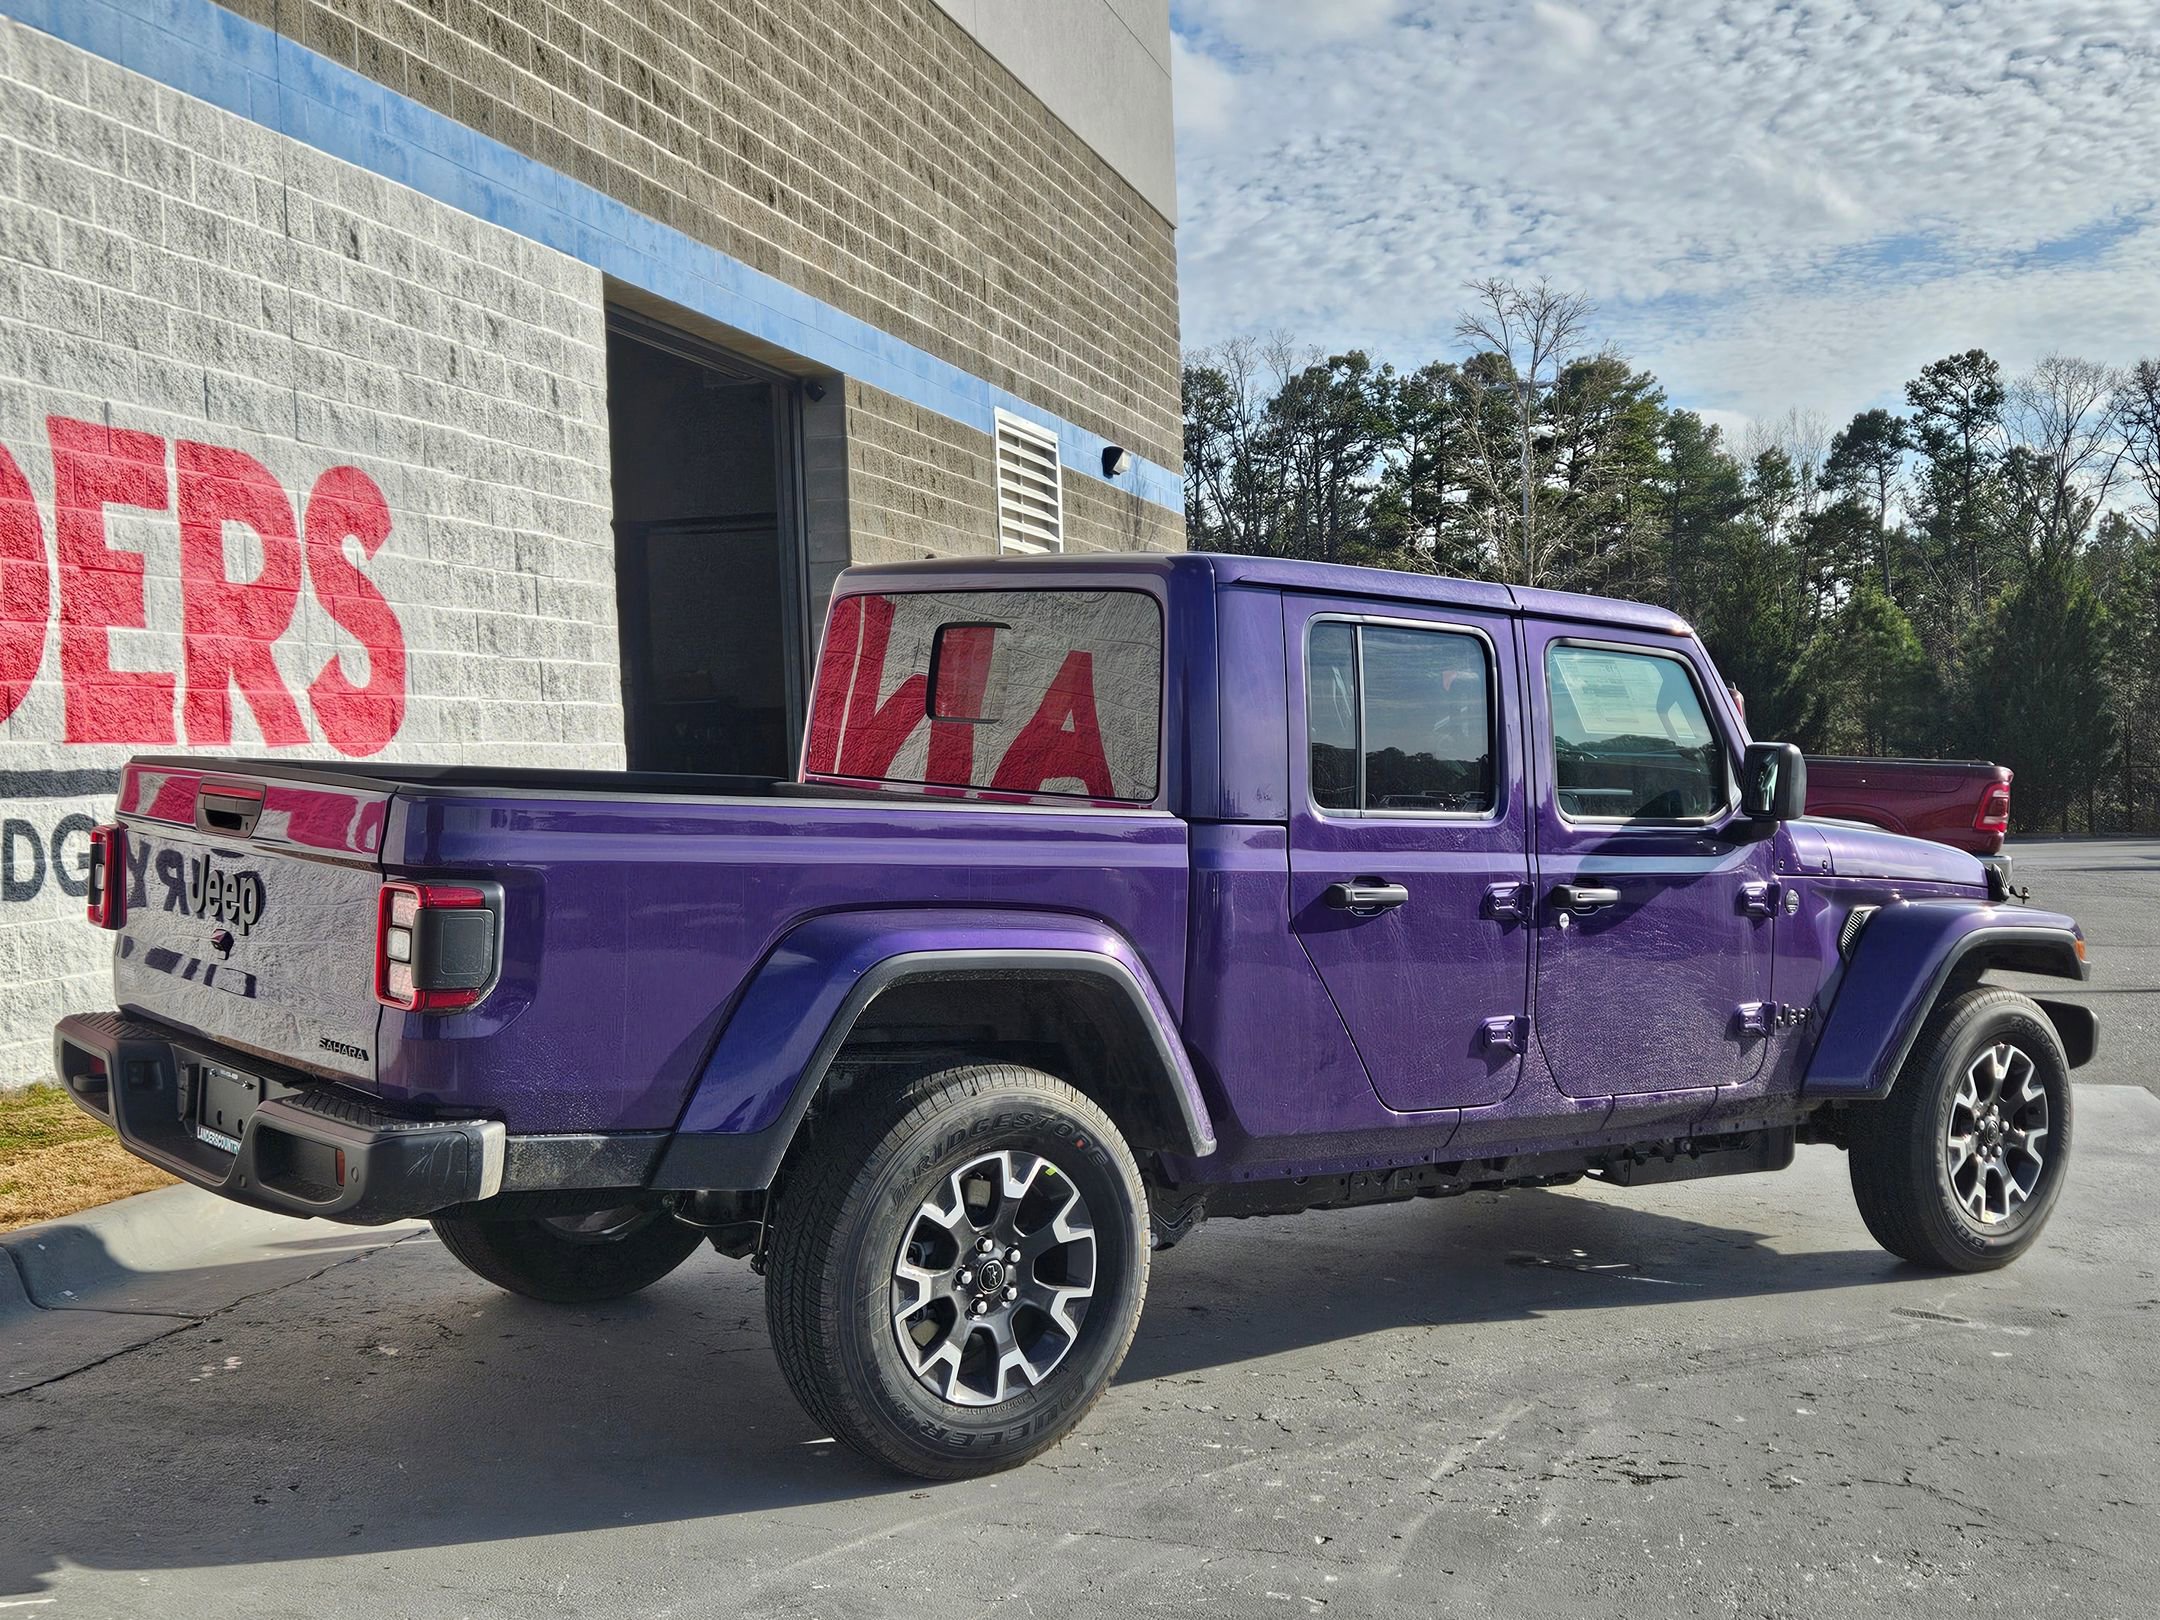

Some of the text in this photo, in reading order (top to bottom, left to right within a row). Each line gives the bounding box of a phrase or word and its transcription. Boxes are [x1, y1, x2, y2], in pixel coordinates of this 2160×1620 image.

[187, 854, 262, 936] Jeep
[319, 1037, 369, 1061] SAHARA
[891, 1112, 1109, 1208] BRIDGESTONE
